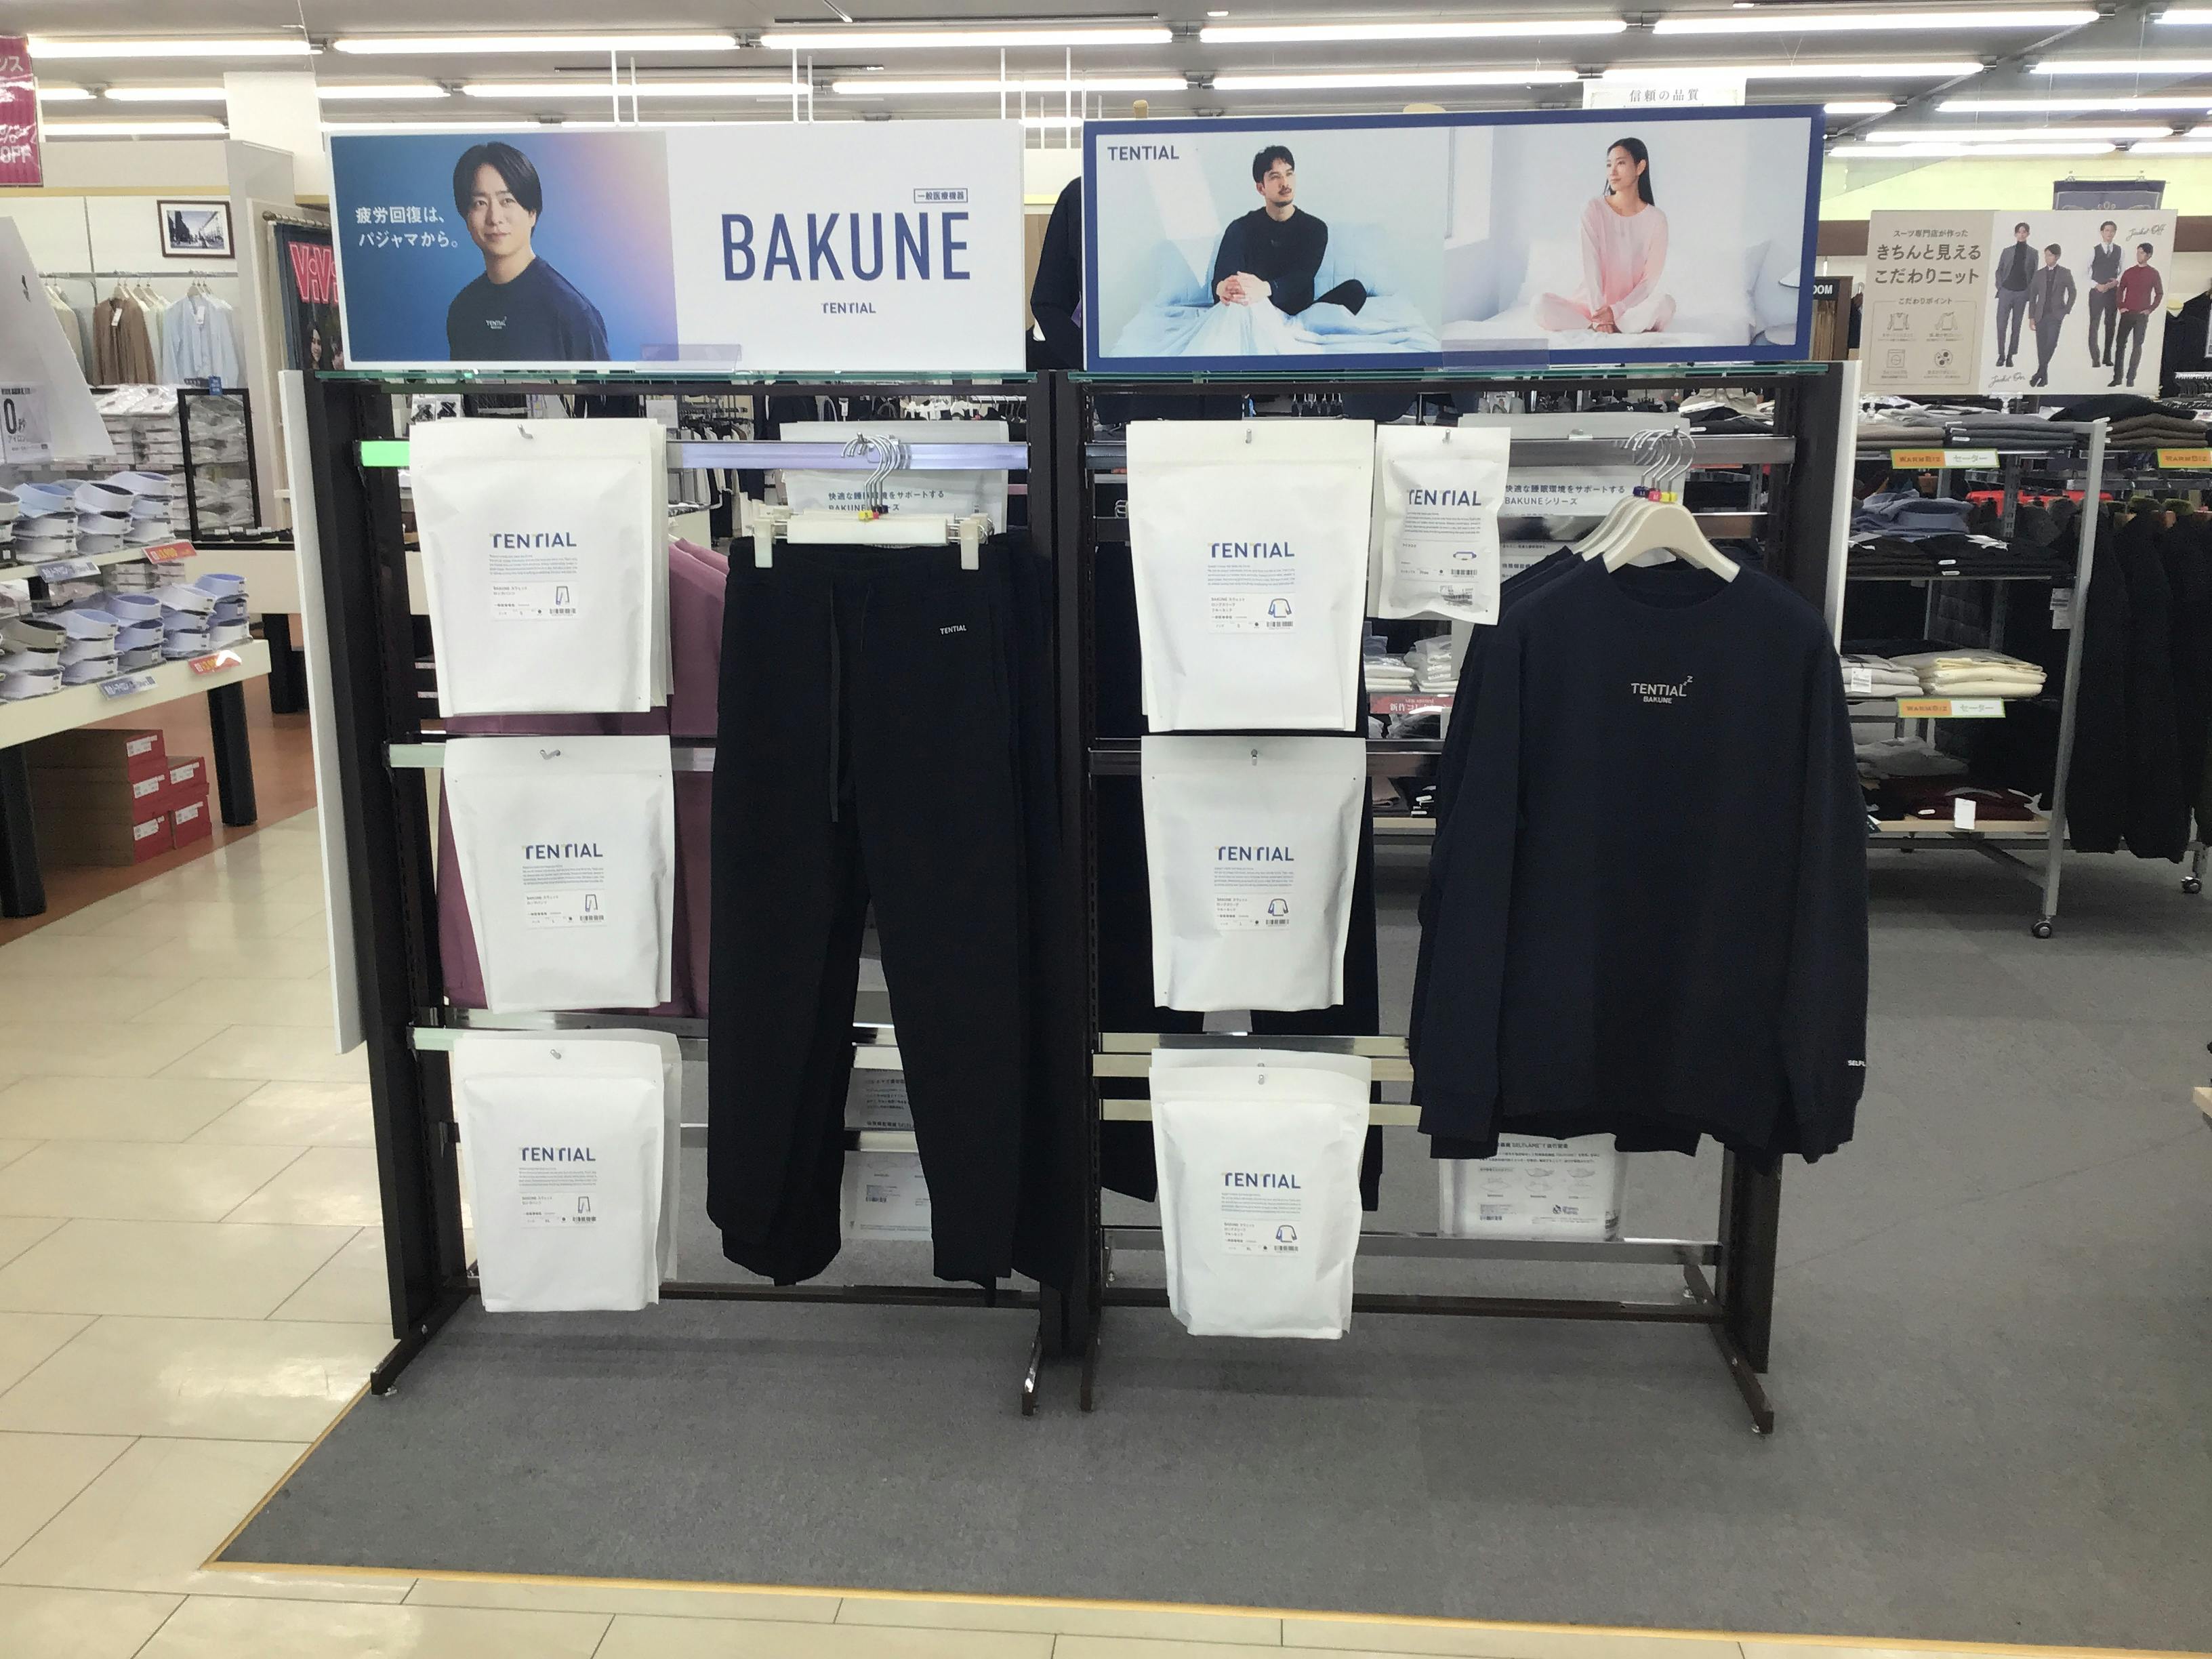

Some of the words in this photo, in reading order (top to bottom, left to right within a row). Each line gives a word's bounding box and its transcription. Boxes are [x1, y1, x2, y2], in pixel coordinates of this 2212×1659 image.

[1630, 89, 1699, 102] 信頼の品質
[1107, 145, 1179, 161] TENTIAL
[917, 191, 964, 200] 一般医療機器
[356, 206, 445, 224] 疲労回復は、
[359, 230, 458, 249] パジャマから。
[722, 211, 970, 281] BAKUNE
[1877, 244, 1982, 261] きちんと見える
[1875, 268, 1979, 285] こだわりニット
[821, 302, 876, 314] TENTIAL
[1408, 489, 1481, 506] TENTIAL
[490, 532, 577, 548] TENTIAL
[1208, 541, 1295, 558] TENTIAL
[939, 624, 967, 635] TENTIAL
[1631, 682, 1687, 697] TENTIAL
[522, 843, 603, 859] TENTIAL
[1215, 846, 1294, 861] TENTIAL
[520, 1147, 596, 1162] TENTIAL
[1222, 1172, 1300, 1189] TENTIAL
